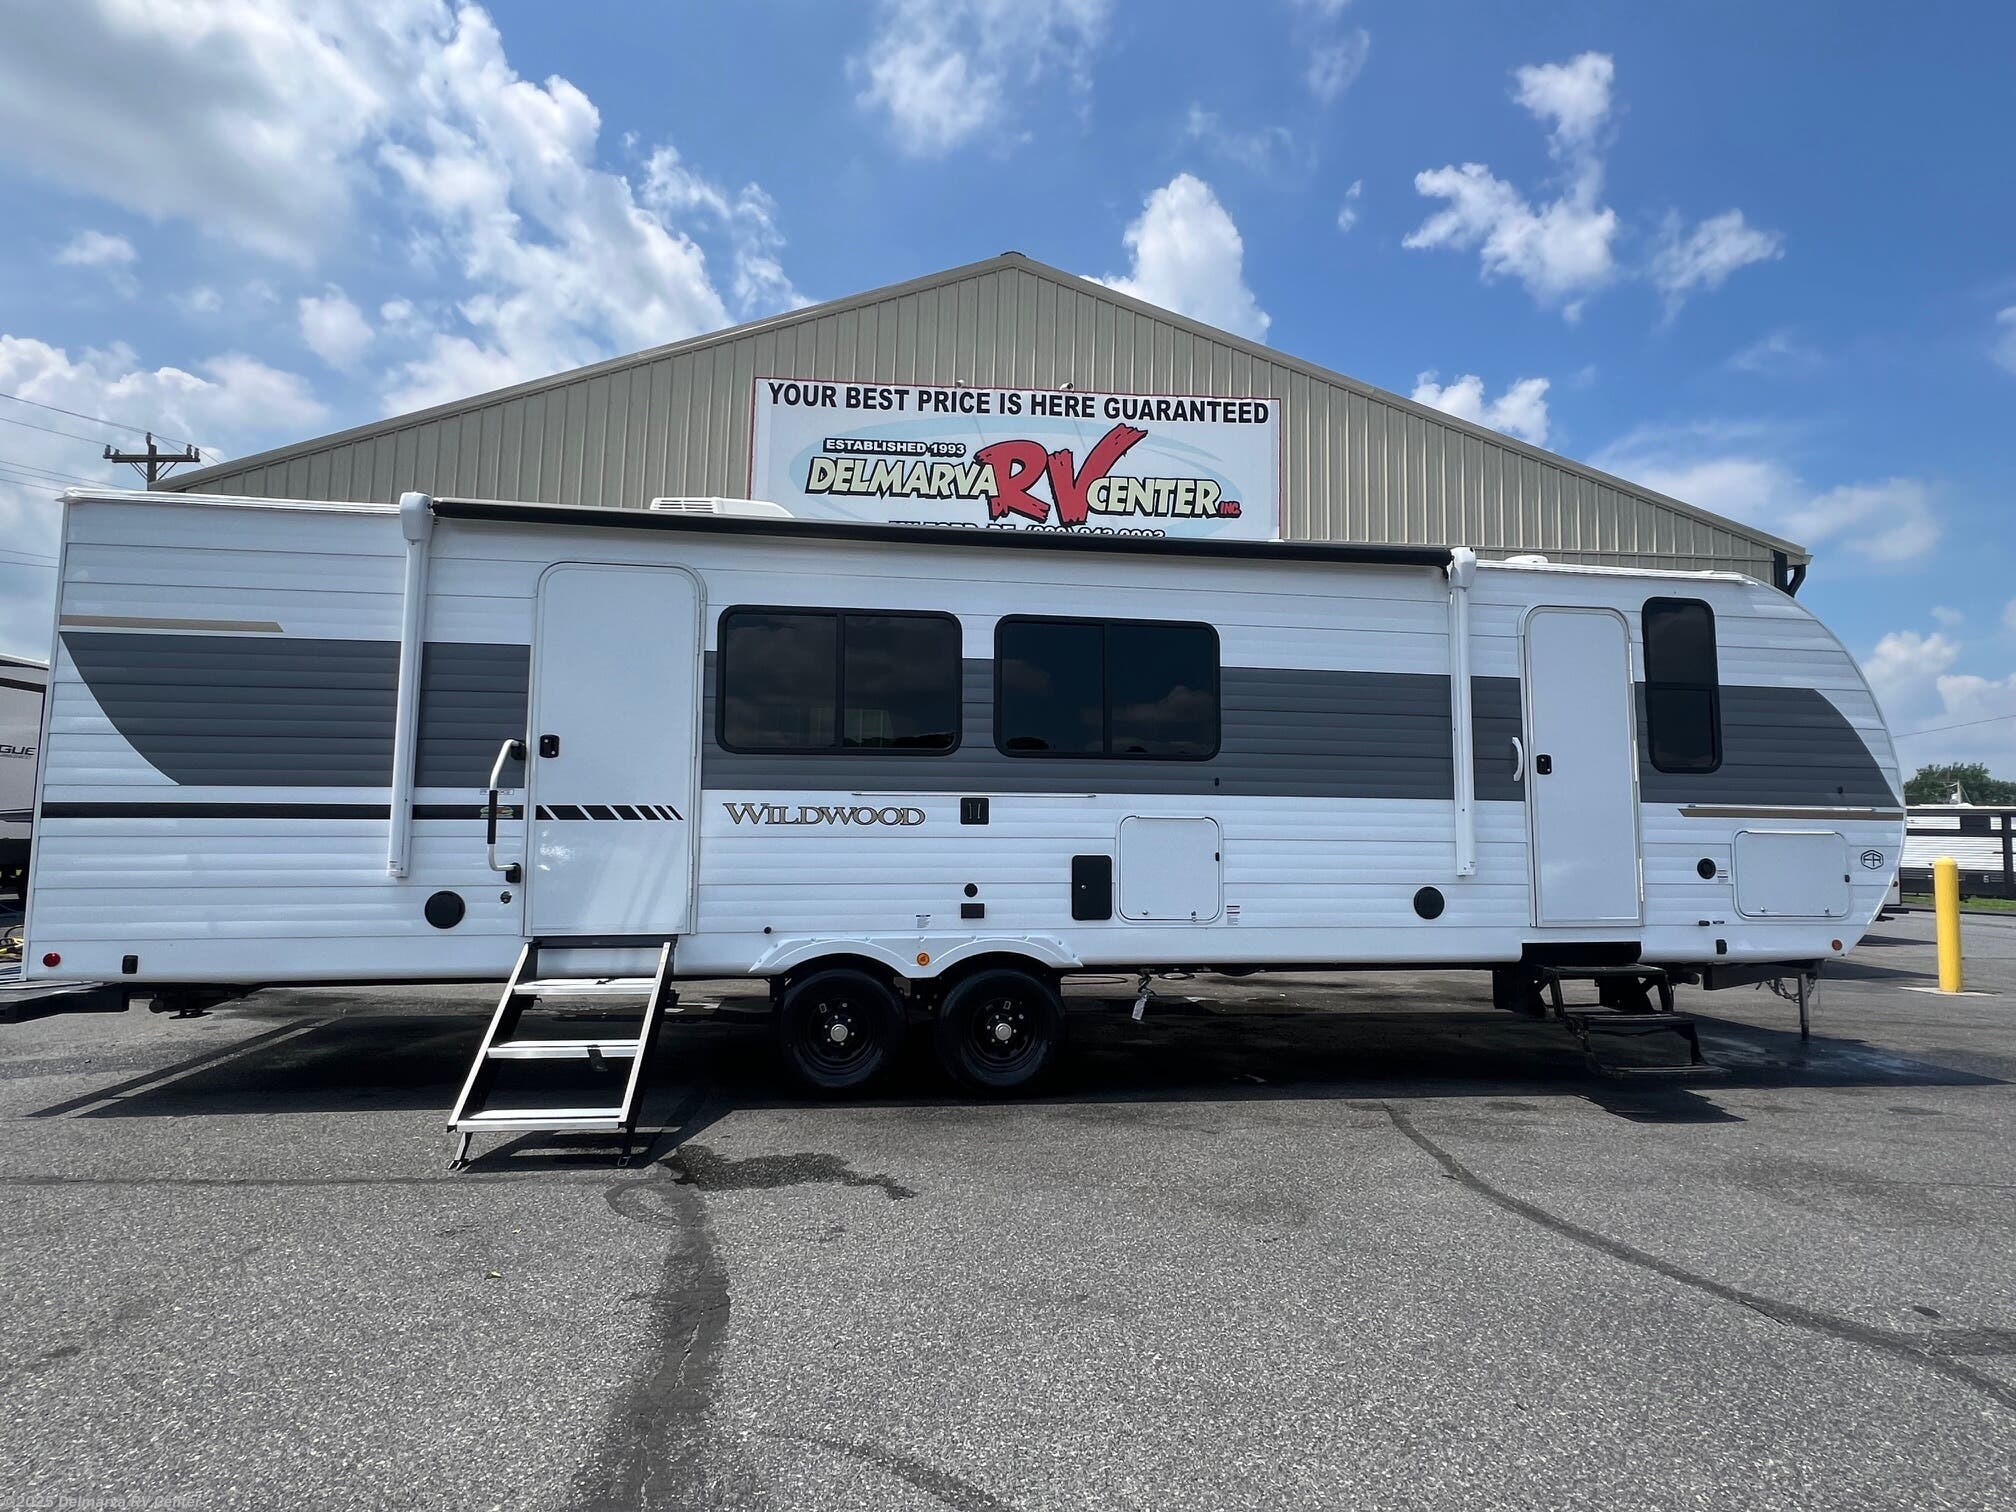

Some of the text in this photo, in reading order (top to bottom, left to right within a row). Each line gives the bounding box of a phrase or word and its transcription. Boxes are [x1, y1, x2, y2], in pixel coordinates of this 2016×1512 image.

[768, 382, 1269, 424] YOUR BEST PRICE IS HERE GUARANTEED
[825, 438, 966, 455] ESTABLISHED 1993
[806, 457, 1000, 499] DELMARVA
[974, 422, 1149, 526] RV
[1086, 477, 1221, 517] CENTER
[722, 802, 926, 826] WILDWOOD
